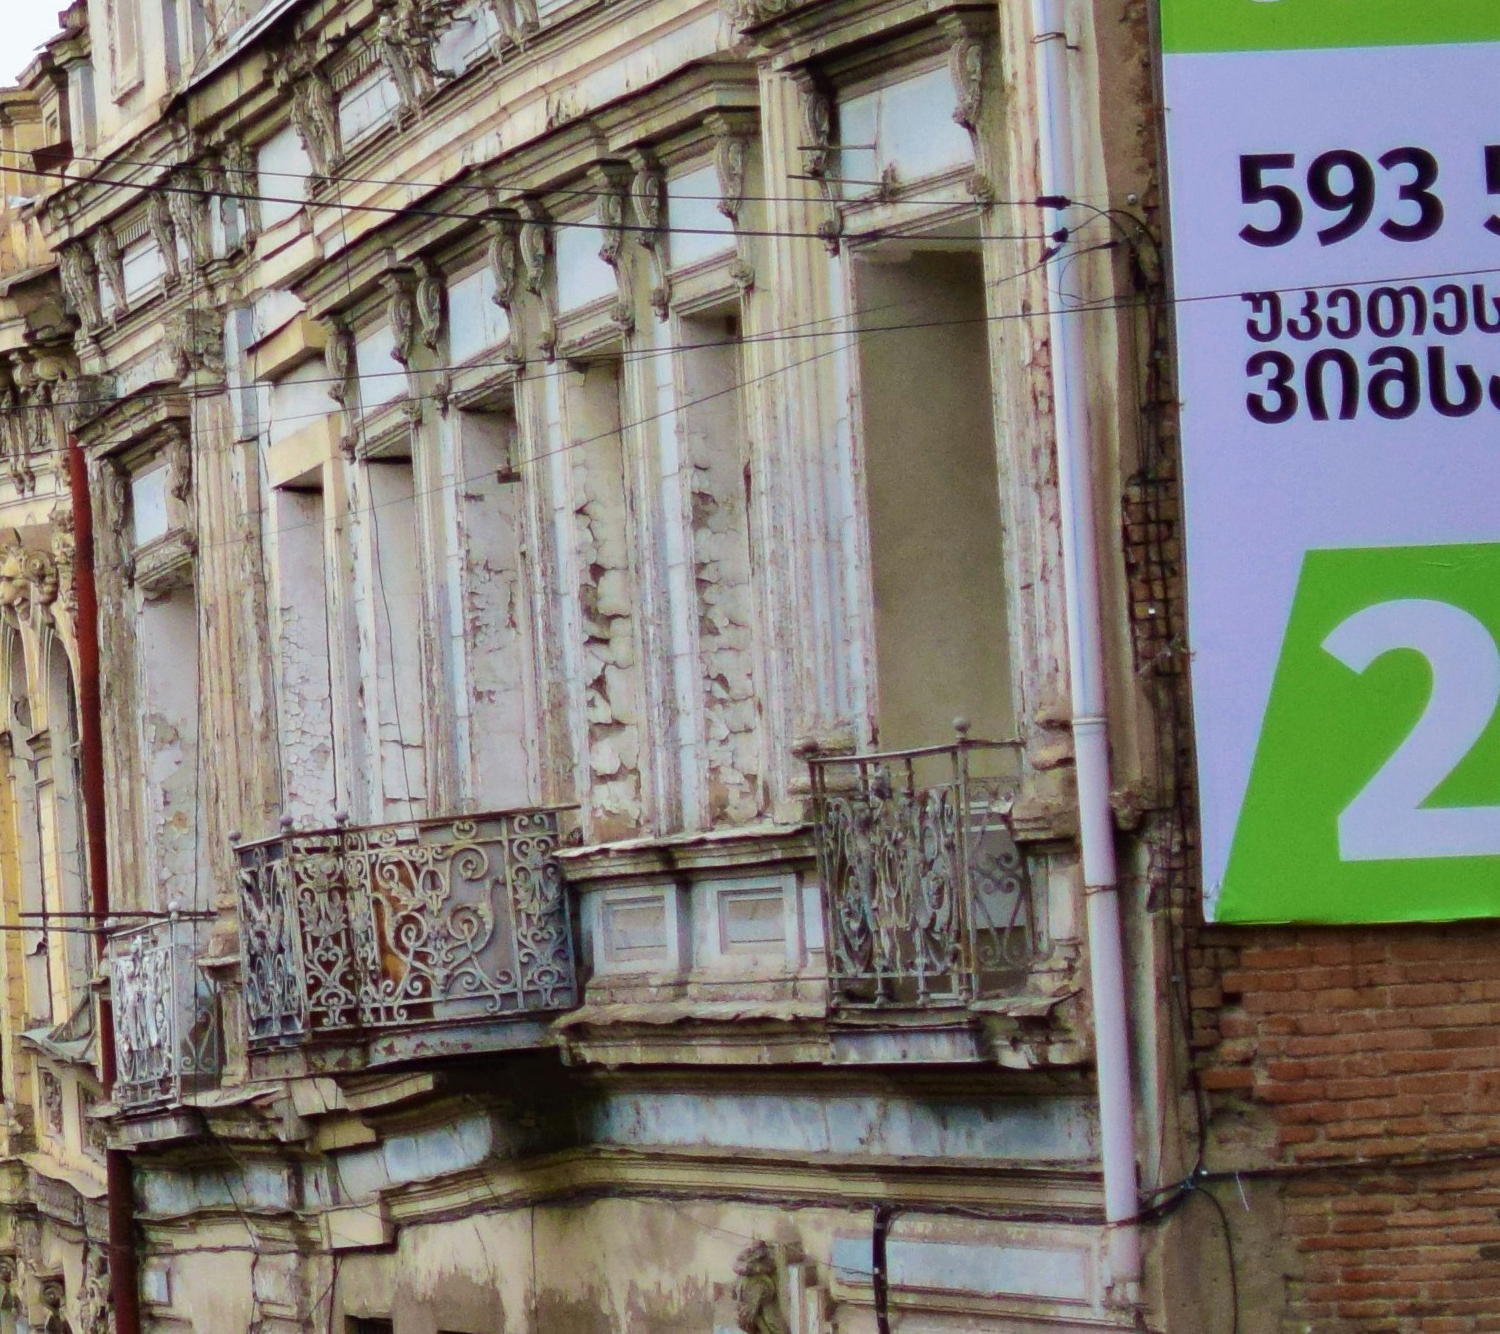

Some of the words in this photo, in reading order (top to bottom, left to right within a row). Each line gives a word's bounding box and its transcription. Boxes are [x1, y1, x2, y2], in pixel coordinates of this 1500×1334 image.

[1238, 147, 1445, 247] 593
[1246, 345, 1500, 424] ვიმს
[1320, 598, 1500, 862] 2
